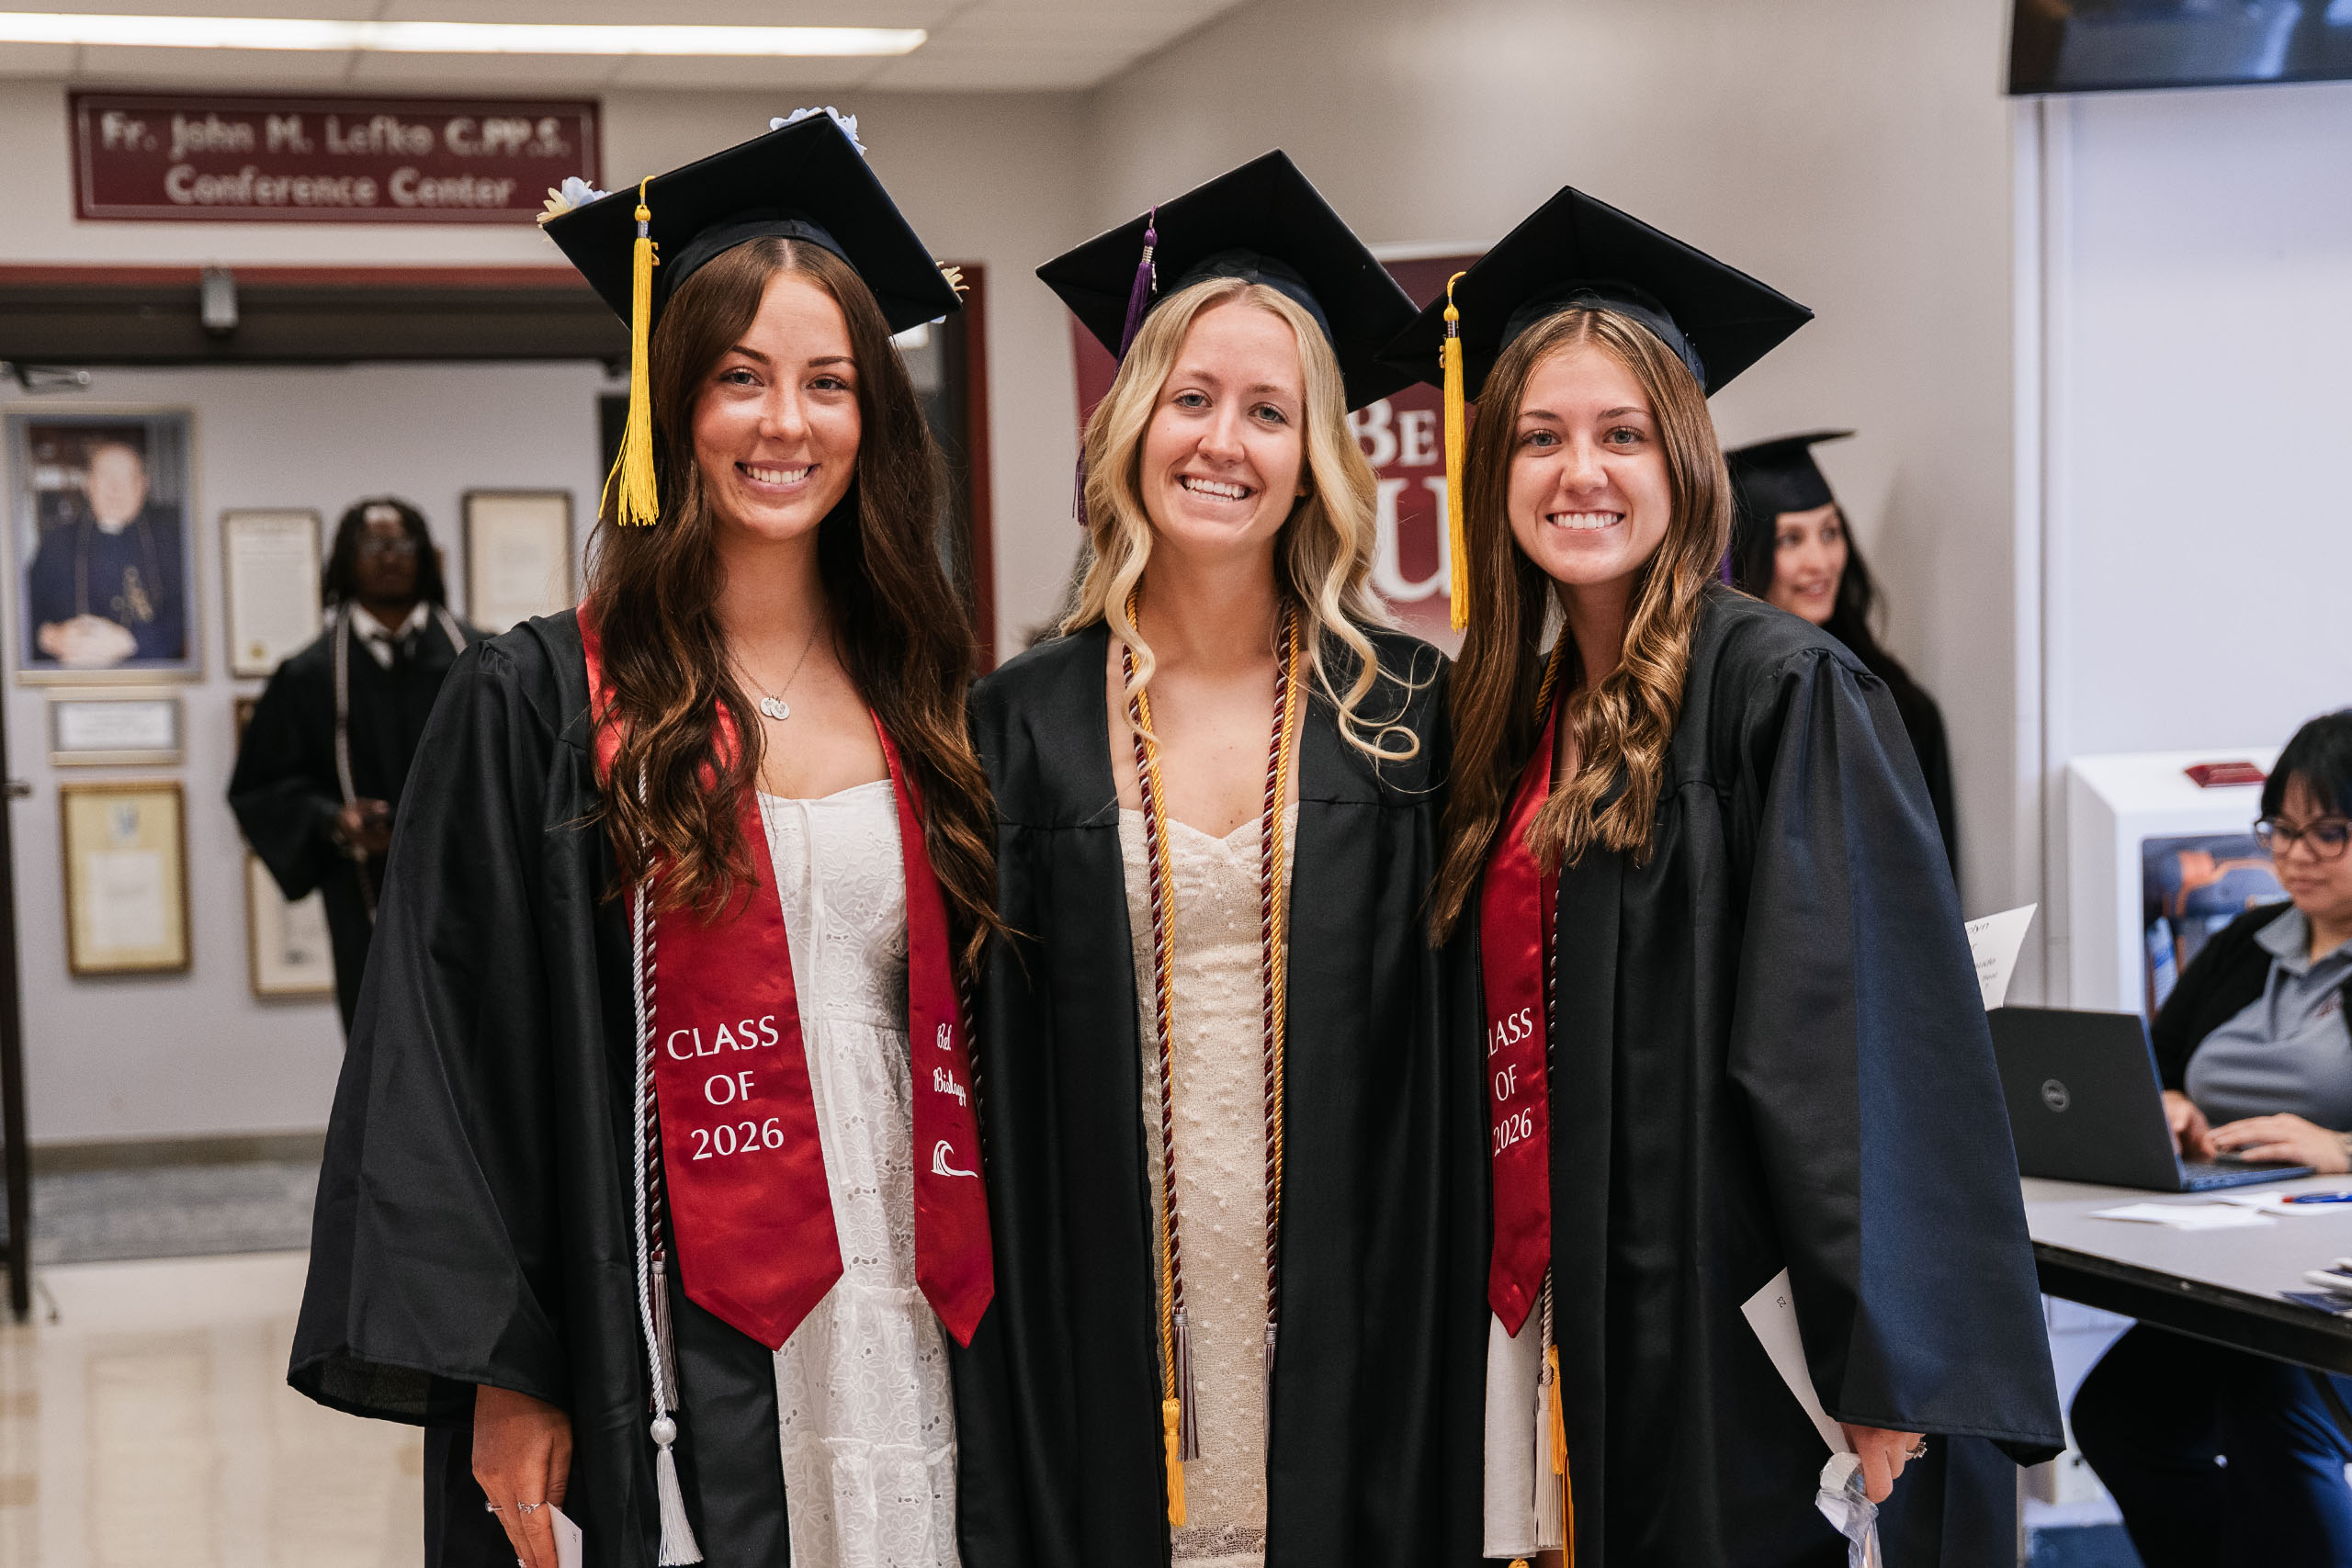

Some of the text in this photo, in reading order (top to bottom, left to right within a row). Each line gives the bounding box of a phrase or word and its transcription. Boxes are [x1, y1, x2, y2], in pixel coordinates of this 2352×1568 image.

[100, 111, 157, 152] Fr.
[168, 112, 254, 162] John
[266, 113, 313, 154] M.
[164, 164, 516, 208] Conference Center
[666, 1014, 780, 1061] CLASS
[1487, 1007, 1532, 1058] LASS
[704, 1070, 756, 1106] OF
[933, 1066, 967, 1108] Biology
[1495, 1064, 1518, 1101] OF
[690, 1117, 785, 1161] 2026
[1493, 1107, 1532, 1157] 2026
